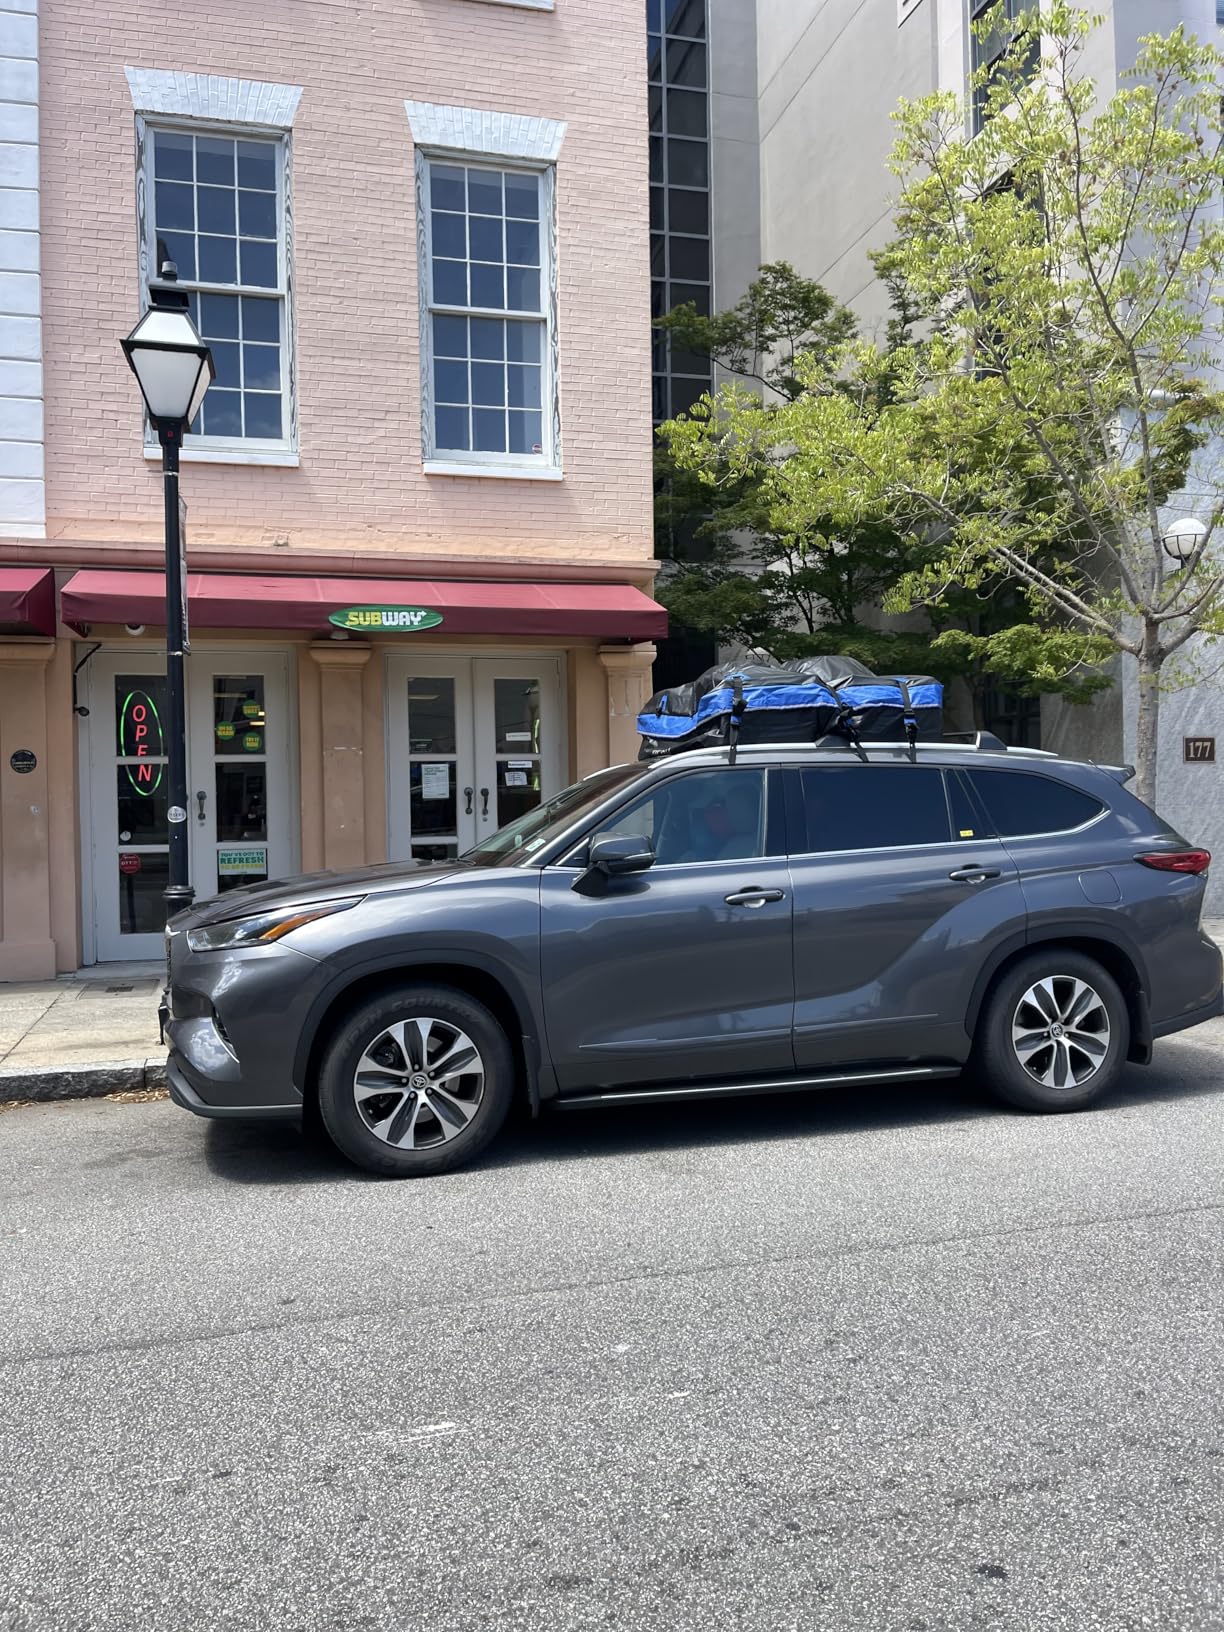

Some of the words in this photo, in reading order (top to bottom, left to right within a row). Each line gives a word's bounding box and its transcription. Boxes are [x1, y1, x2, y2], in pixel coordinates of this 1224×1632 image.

[345, 610, 427, 626] SUBWAY
[132, 704, 152, 782] OPEN
[1188, 741, 1211, 758] 177
[220, 856, 264, 864] REFRESH
